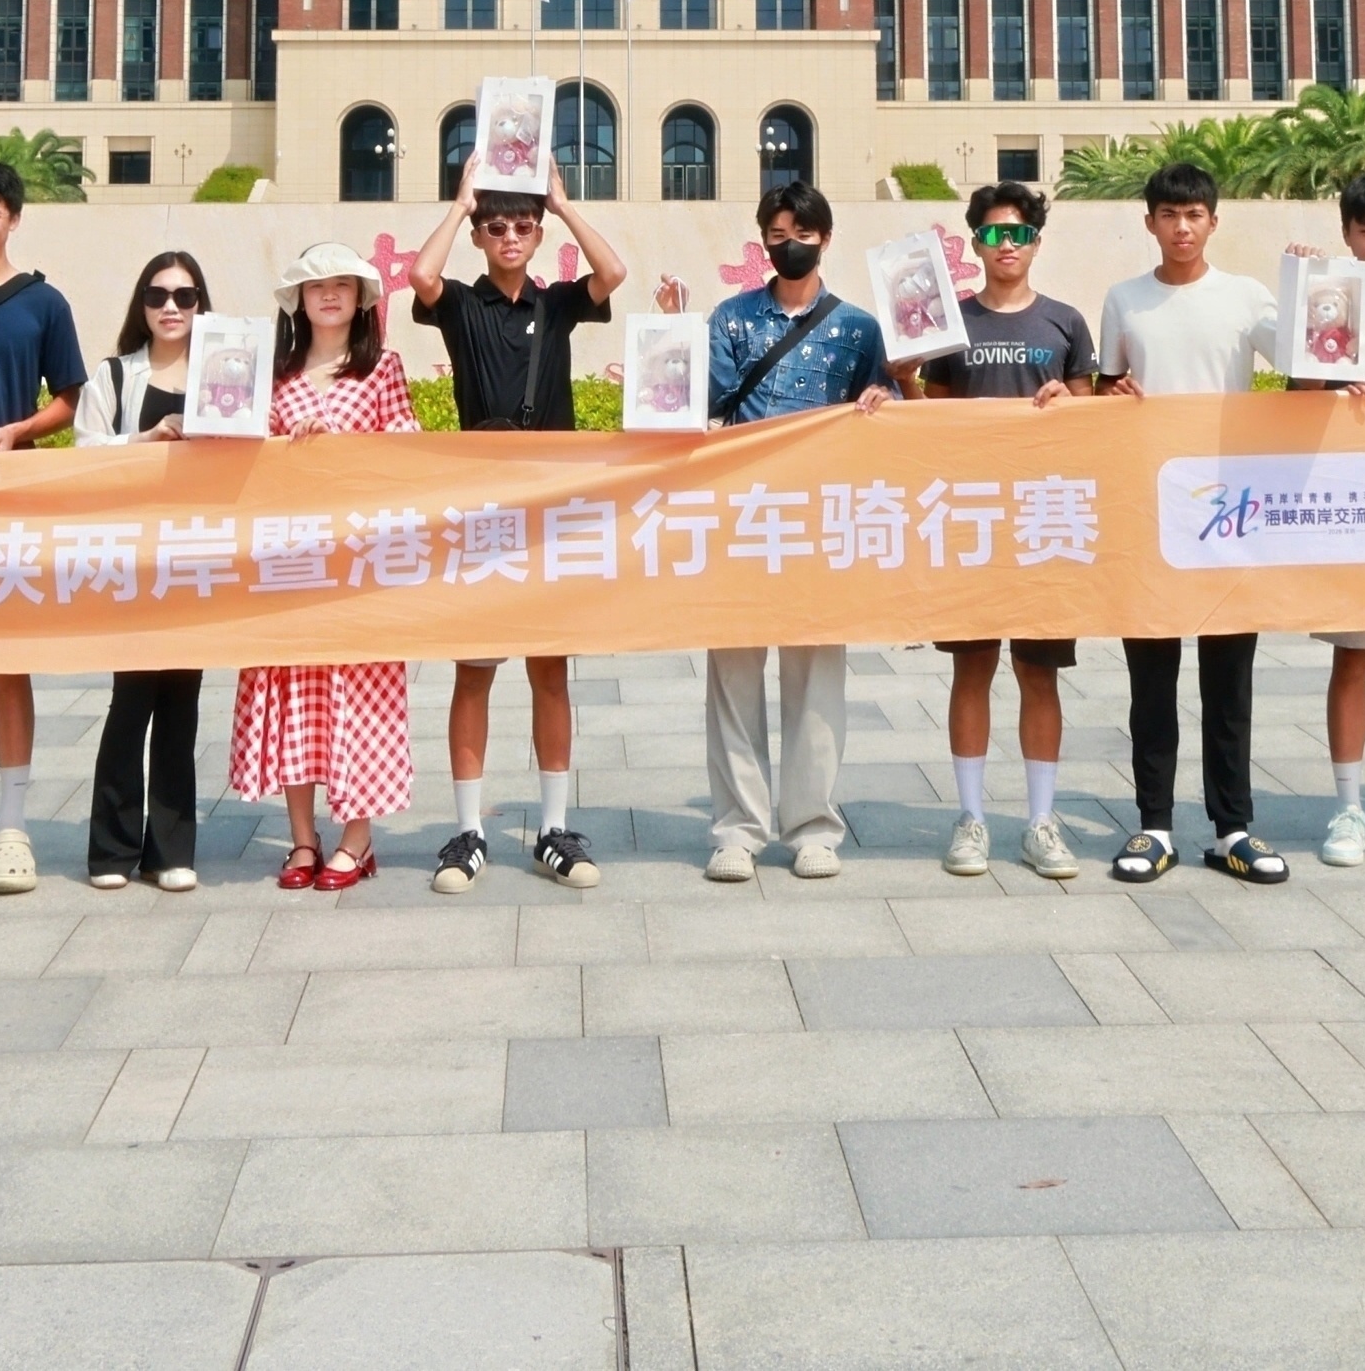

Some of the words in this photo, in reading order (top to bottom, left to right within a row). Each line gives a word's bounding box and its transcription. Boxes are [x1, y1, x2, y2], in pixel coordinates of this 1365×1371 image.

[1264, 491, 1333, 505] 两岸圳青春
